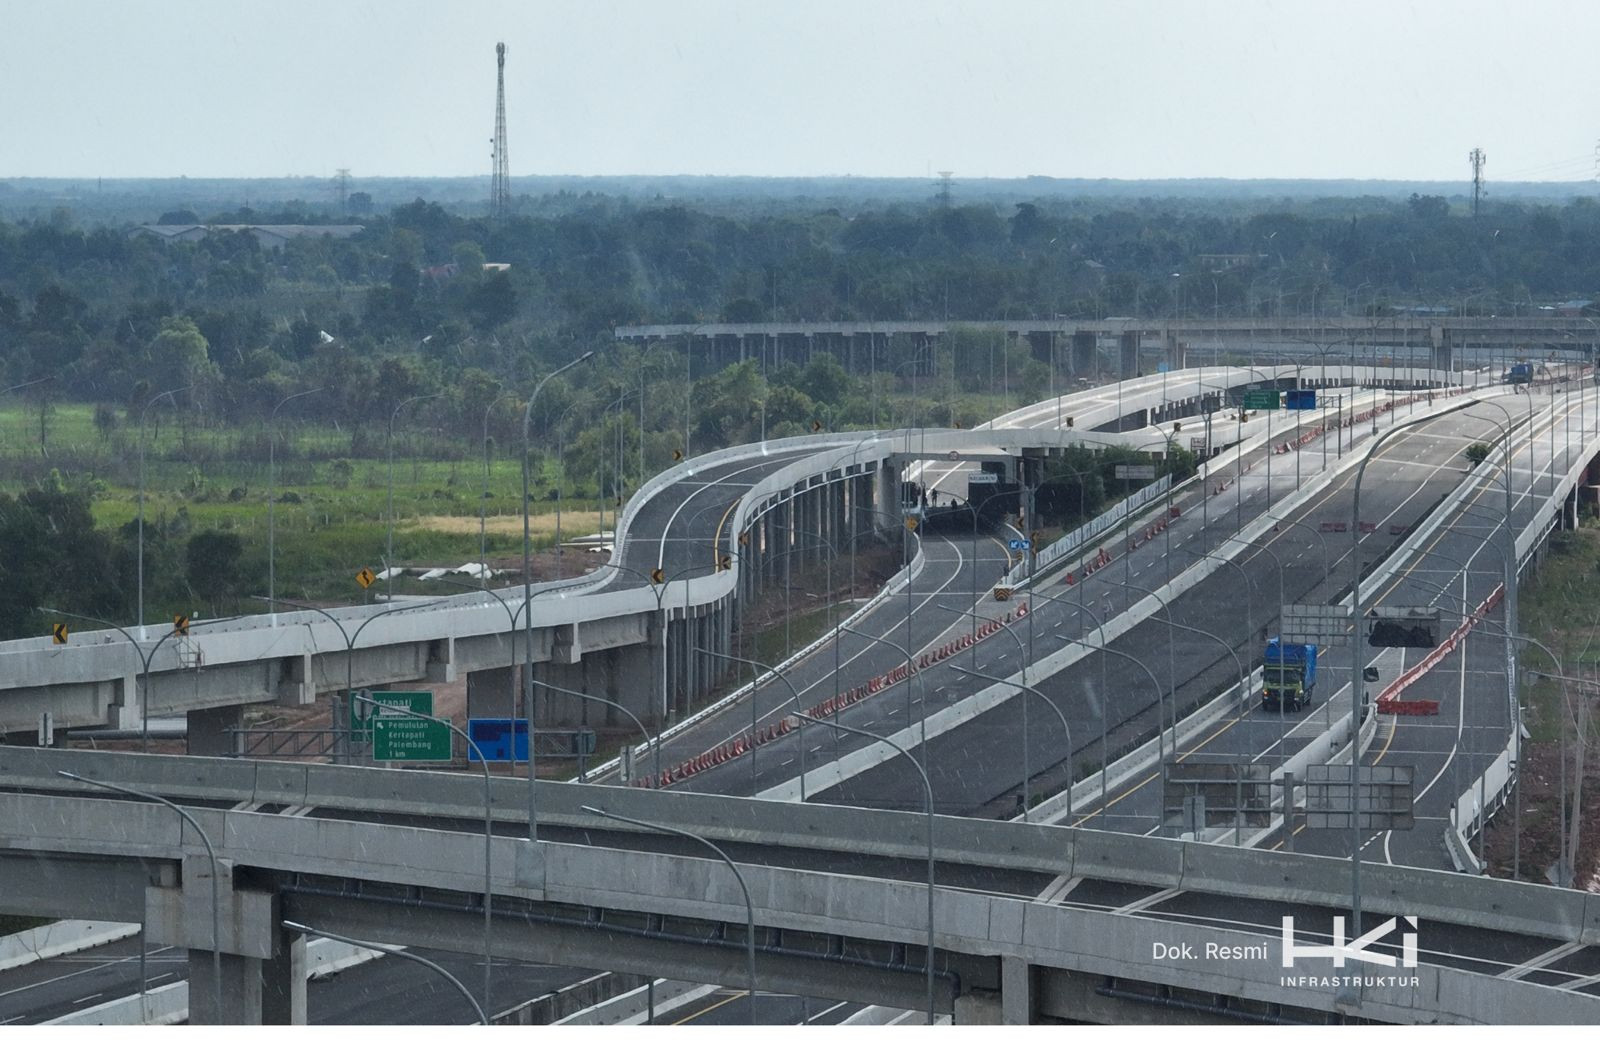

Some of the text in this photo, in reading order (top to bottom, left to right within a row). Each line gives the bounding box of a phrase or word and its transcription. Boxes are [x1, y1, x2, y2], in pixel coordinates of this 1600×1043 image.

[388, 731, 425, 740] Kertapati
[388, 740, 432, 750] Palembang
[395, 750, 406, 758] km
